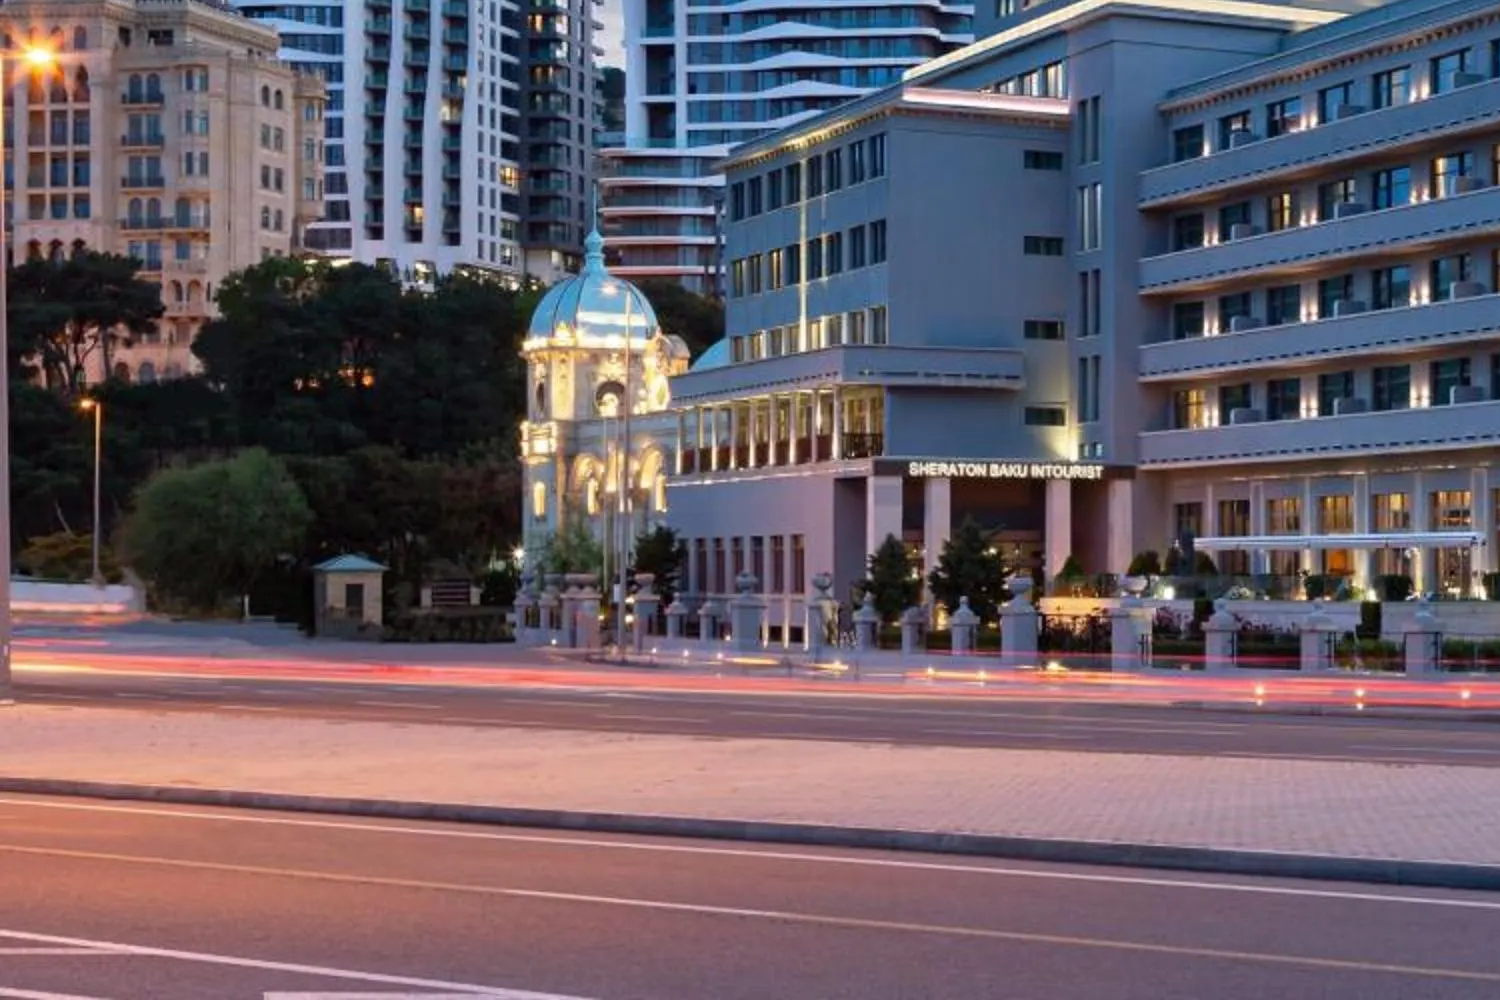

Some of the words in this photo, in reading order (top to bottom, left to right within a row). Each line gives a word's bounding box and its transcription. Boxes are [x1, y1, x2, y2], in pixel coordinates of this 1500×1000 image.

[908, 462, 987, 478] SHERATON
[989, 463, 1028, 479] BAKU
[1031, 464, 1104, 480] INTOURIST
